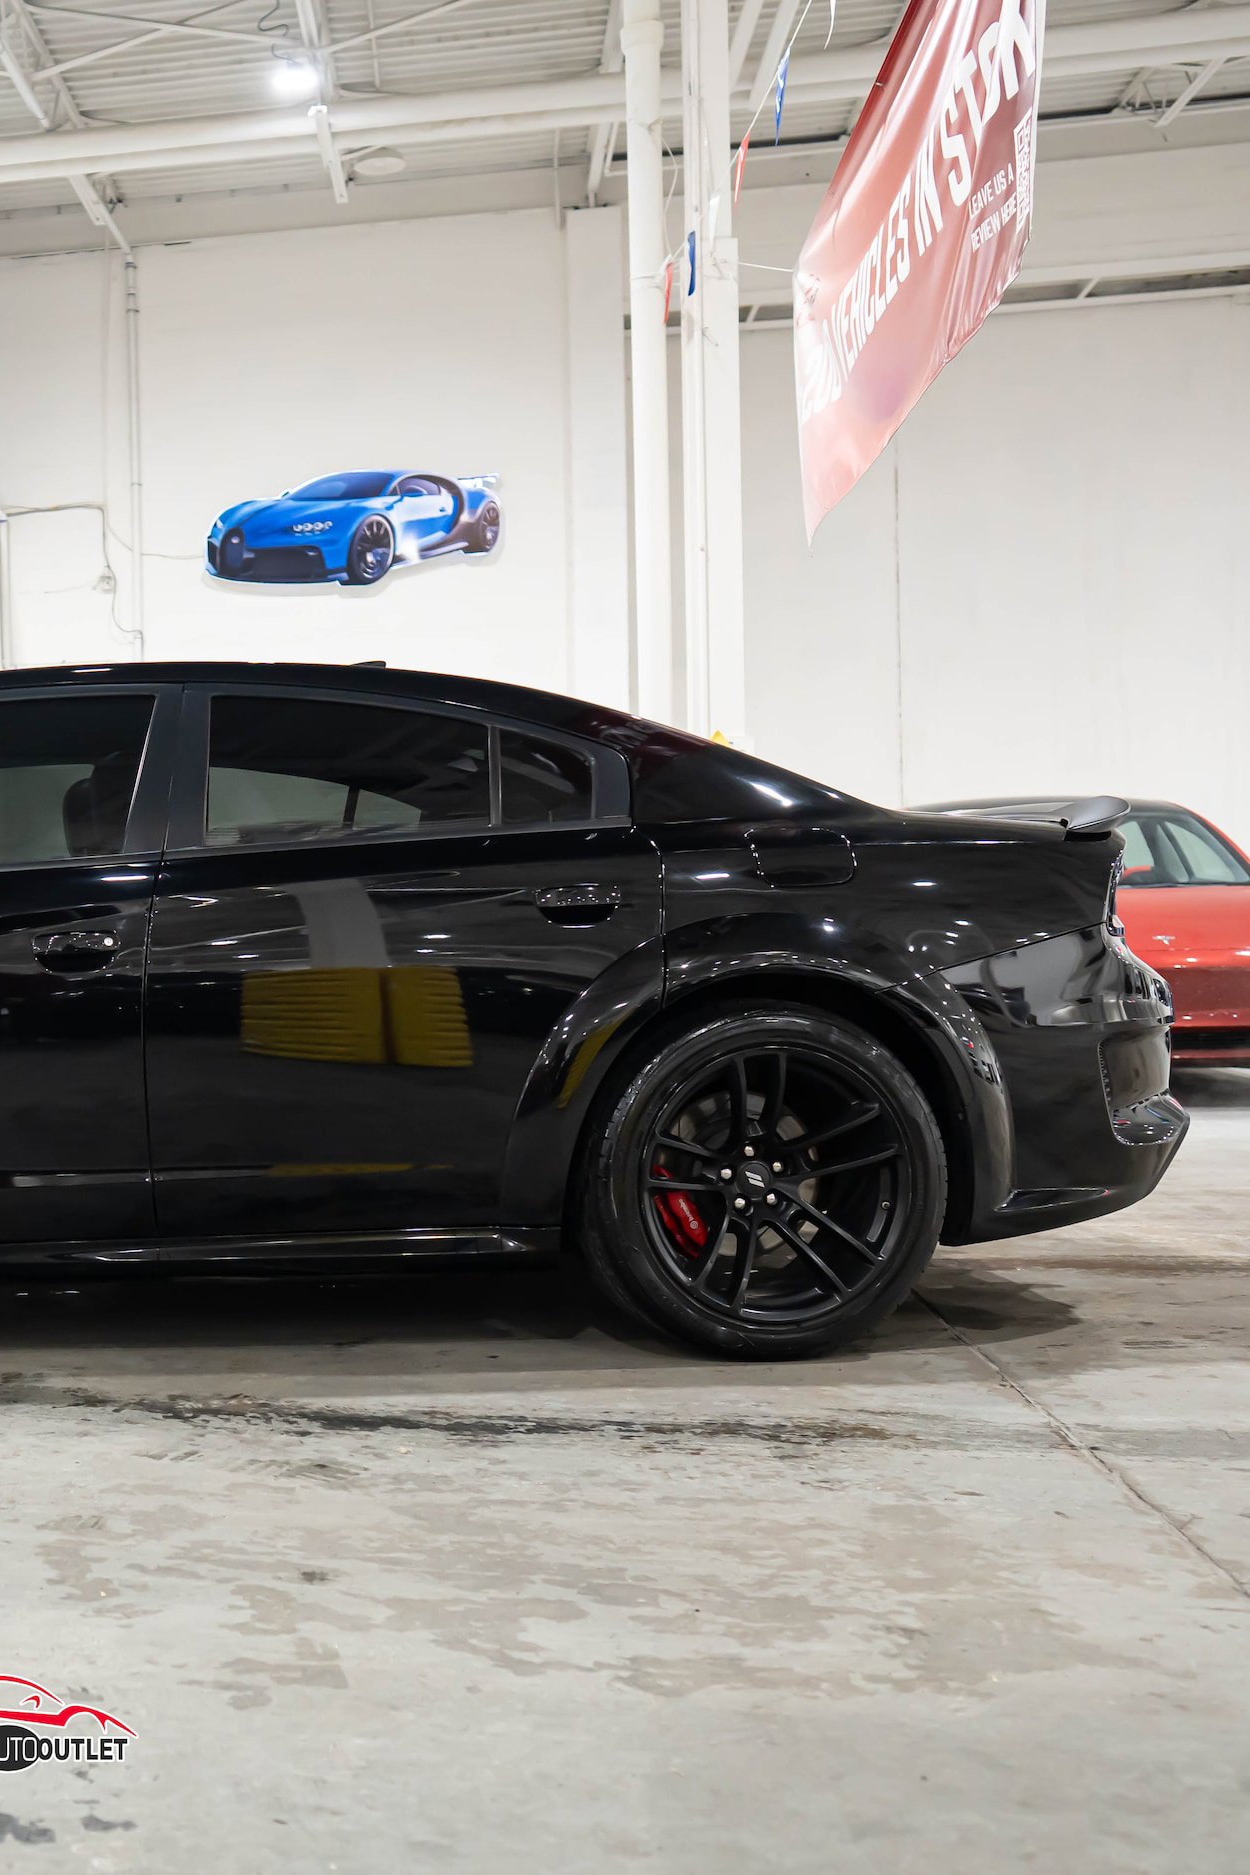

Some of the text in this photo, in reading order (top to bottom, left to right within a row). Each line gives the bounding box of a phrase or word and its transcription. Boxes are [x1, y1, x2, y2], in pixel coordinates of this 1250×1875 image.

[968, 162, 1015, 219] LEAVE US A
[831, 172, 911, 383] VEHICLES
[915, 121, 943, 257] IN
[971, 192, 1017, 253] REVIEW HERE
